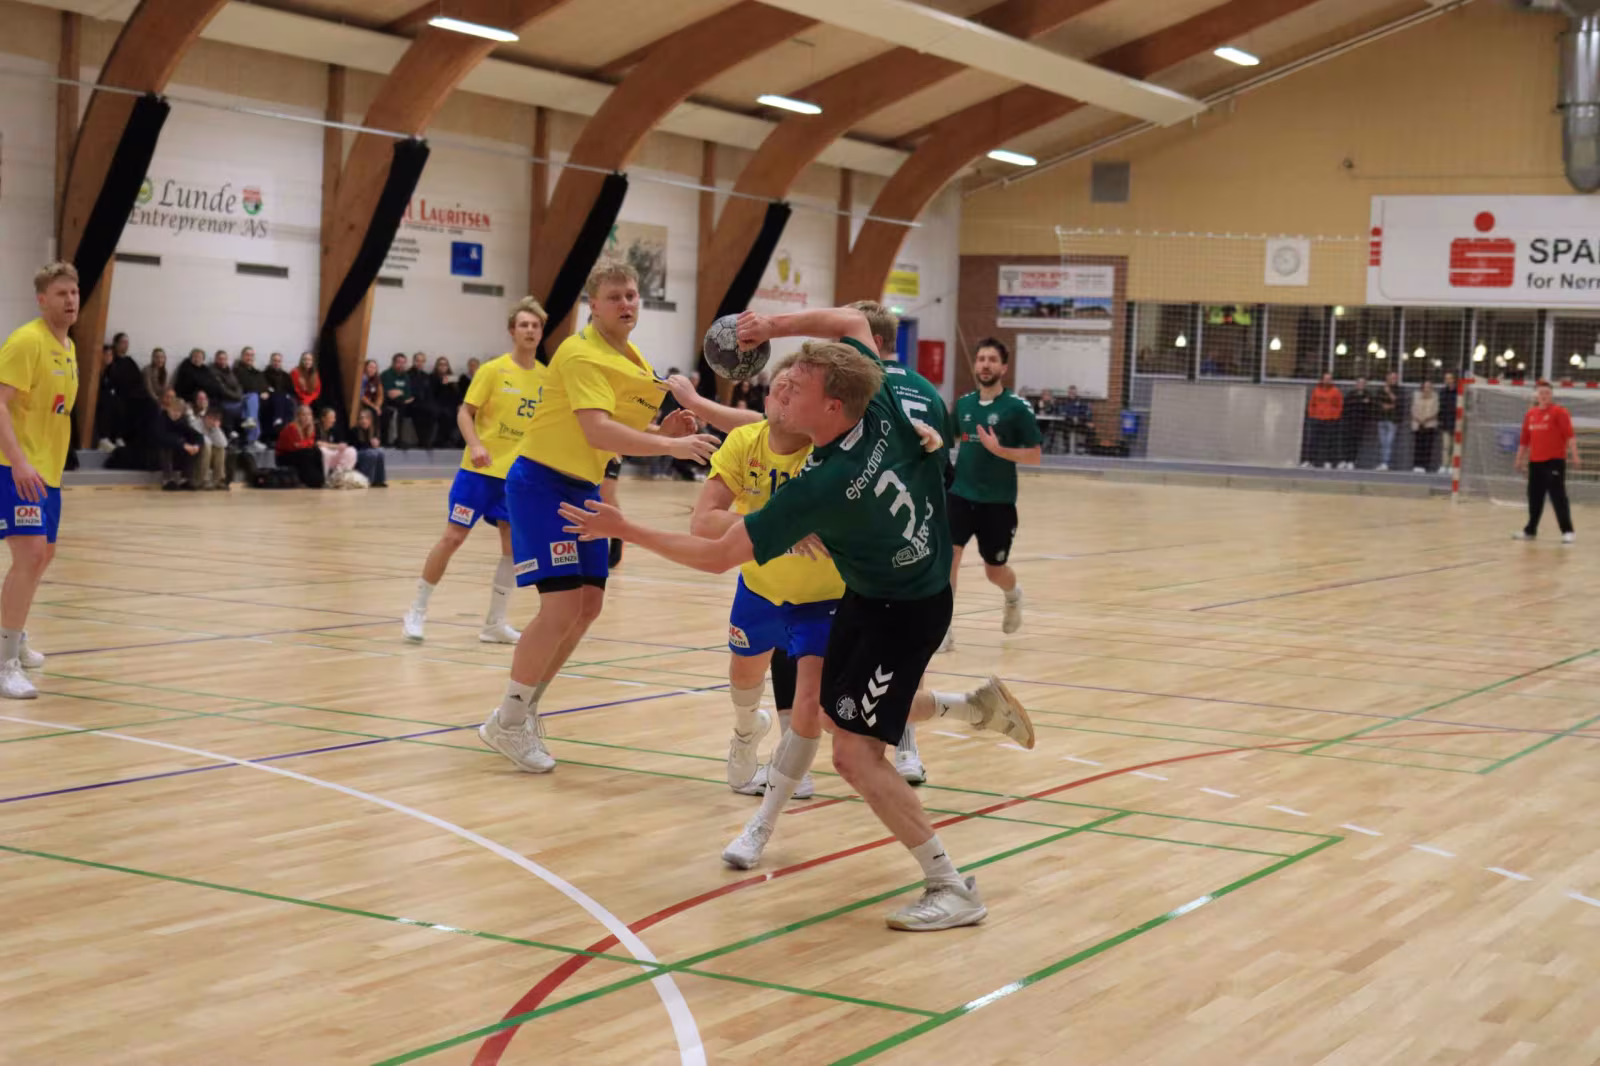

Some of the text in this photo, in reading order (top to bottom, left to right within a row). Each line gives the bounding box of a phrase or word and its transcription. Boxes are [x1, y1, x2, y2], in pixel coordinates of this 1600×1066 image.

[158, 179, 237, 214] Lunde
[1529, 238, 1600, 265] SPA
[1527, 272, 1554, 289] for
[516, 397, 537, 419] 25
[16, 507, 40, 518] OK
[873, 469, 916, 541] 3
[552, 541, 577, 556] OK
[553, 555, 578, 565] BENZ
[729, 626, 743, 640] K
